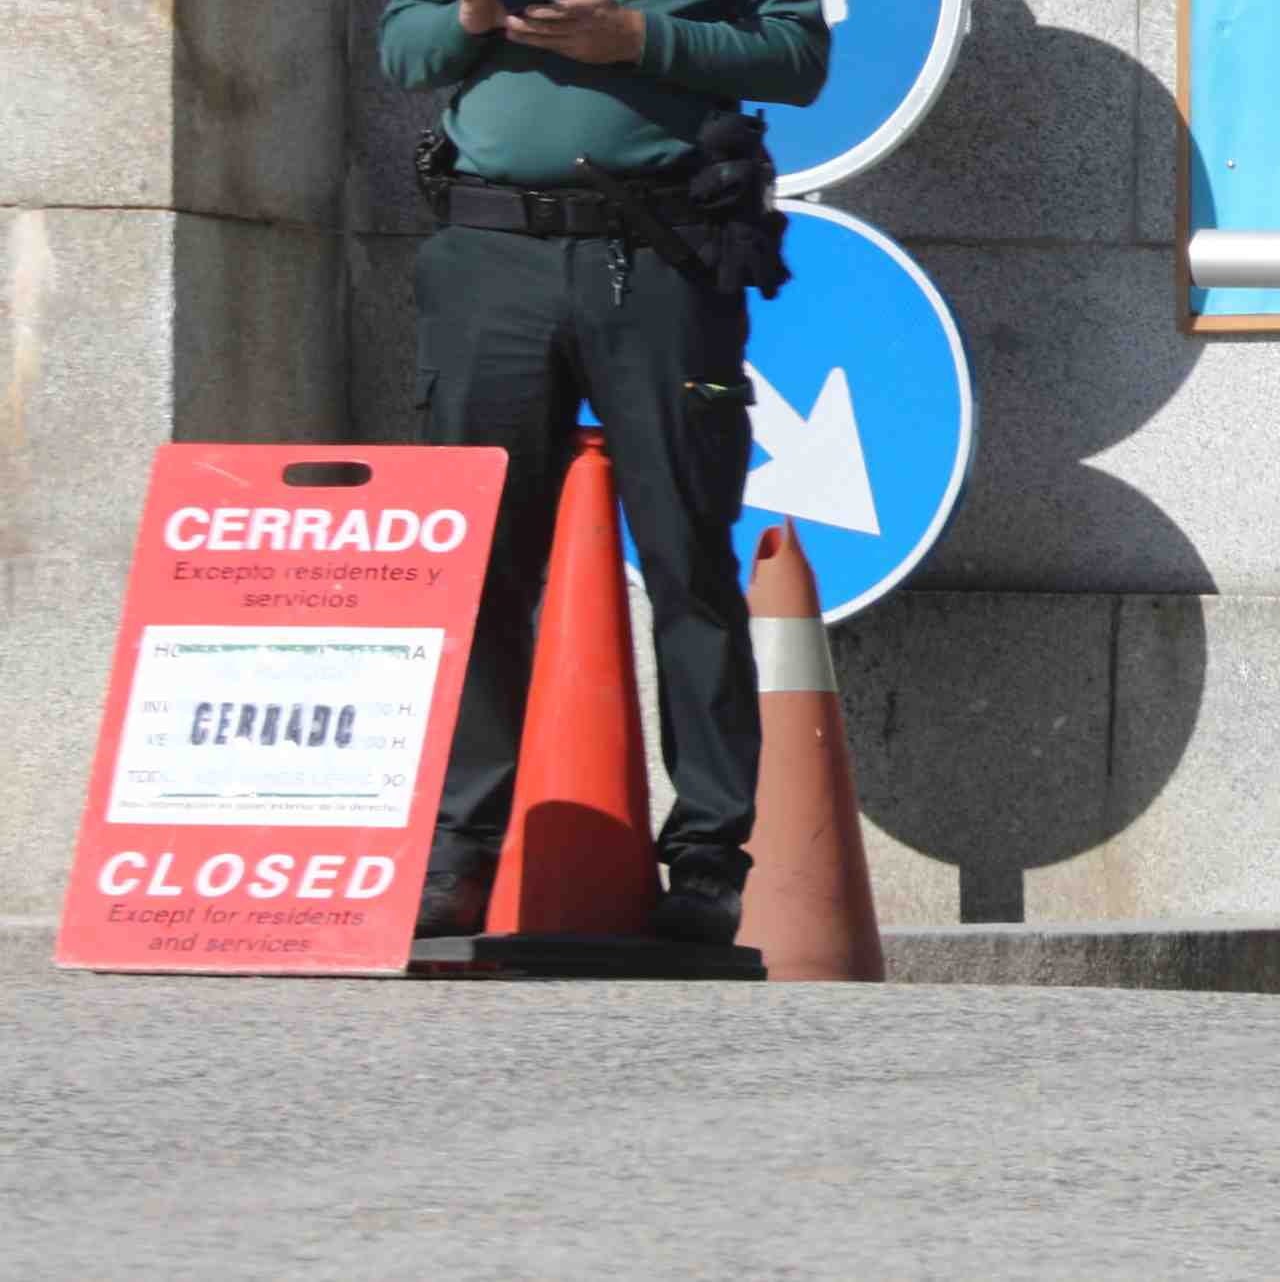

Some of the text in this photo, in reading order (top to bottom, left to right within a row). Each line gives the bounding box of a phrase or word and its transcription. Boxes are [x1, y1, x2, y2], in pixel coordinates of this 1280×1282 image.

[163, 506, 468, 553] CERRADO
[173, 562, 442, 585] Excepto residentes y
[244, 589, 358, 608] servicios
[98, 851, 396, 899] CLOSED
[107, 904, 366, 927] Except for residents
[148, 934, 312, 954] and services
